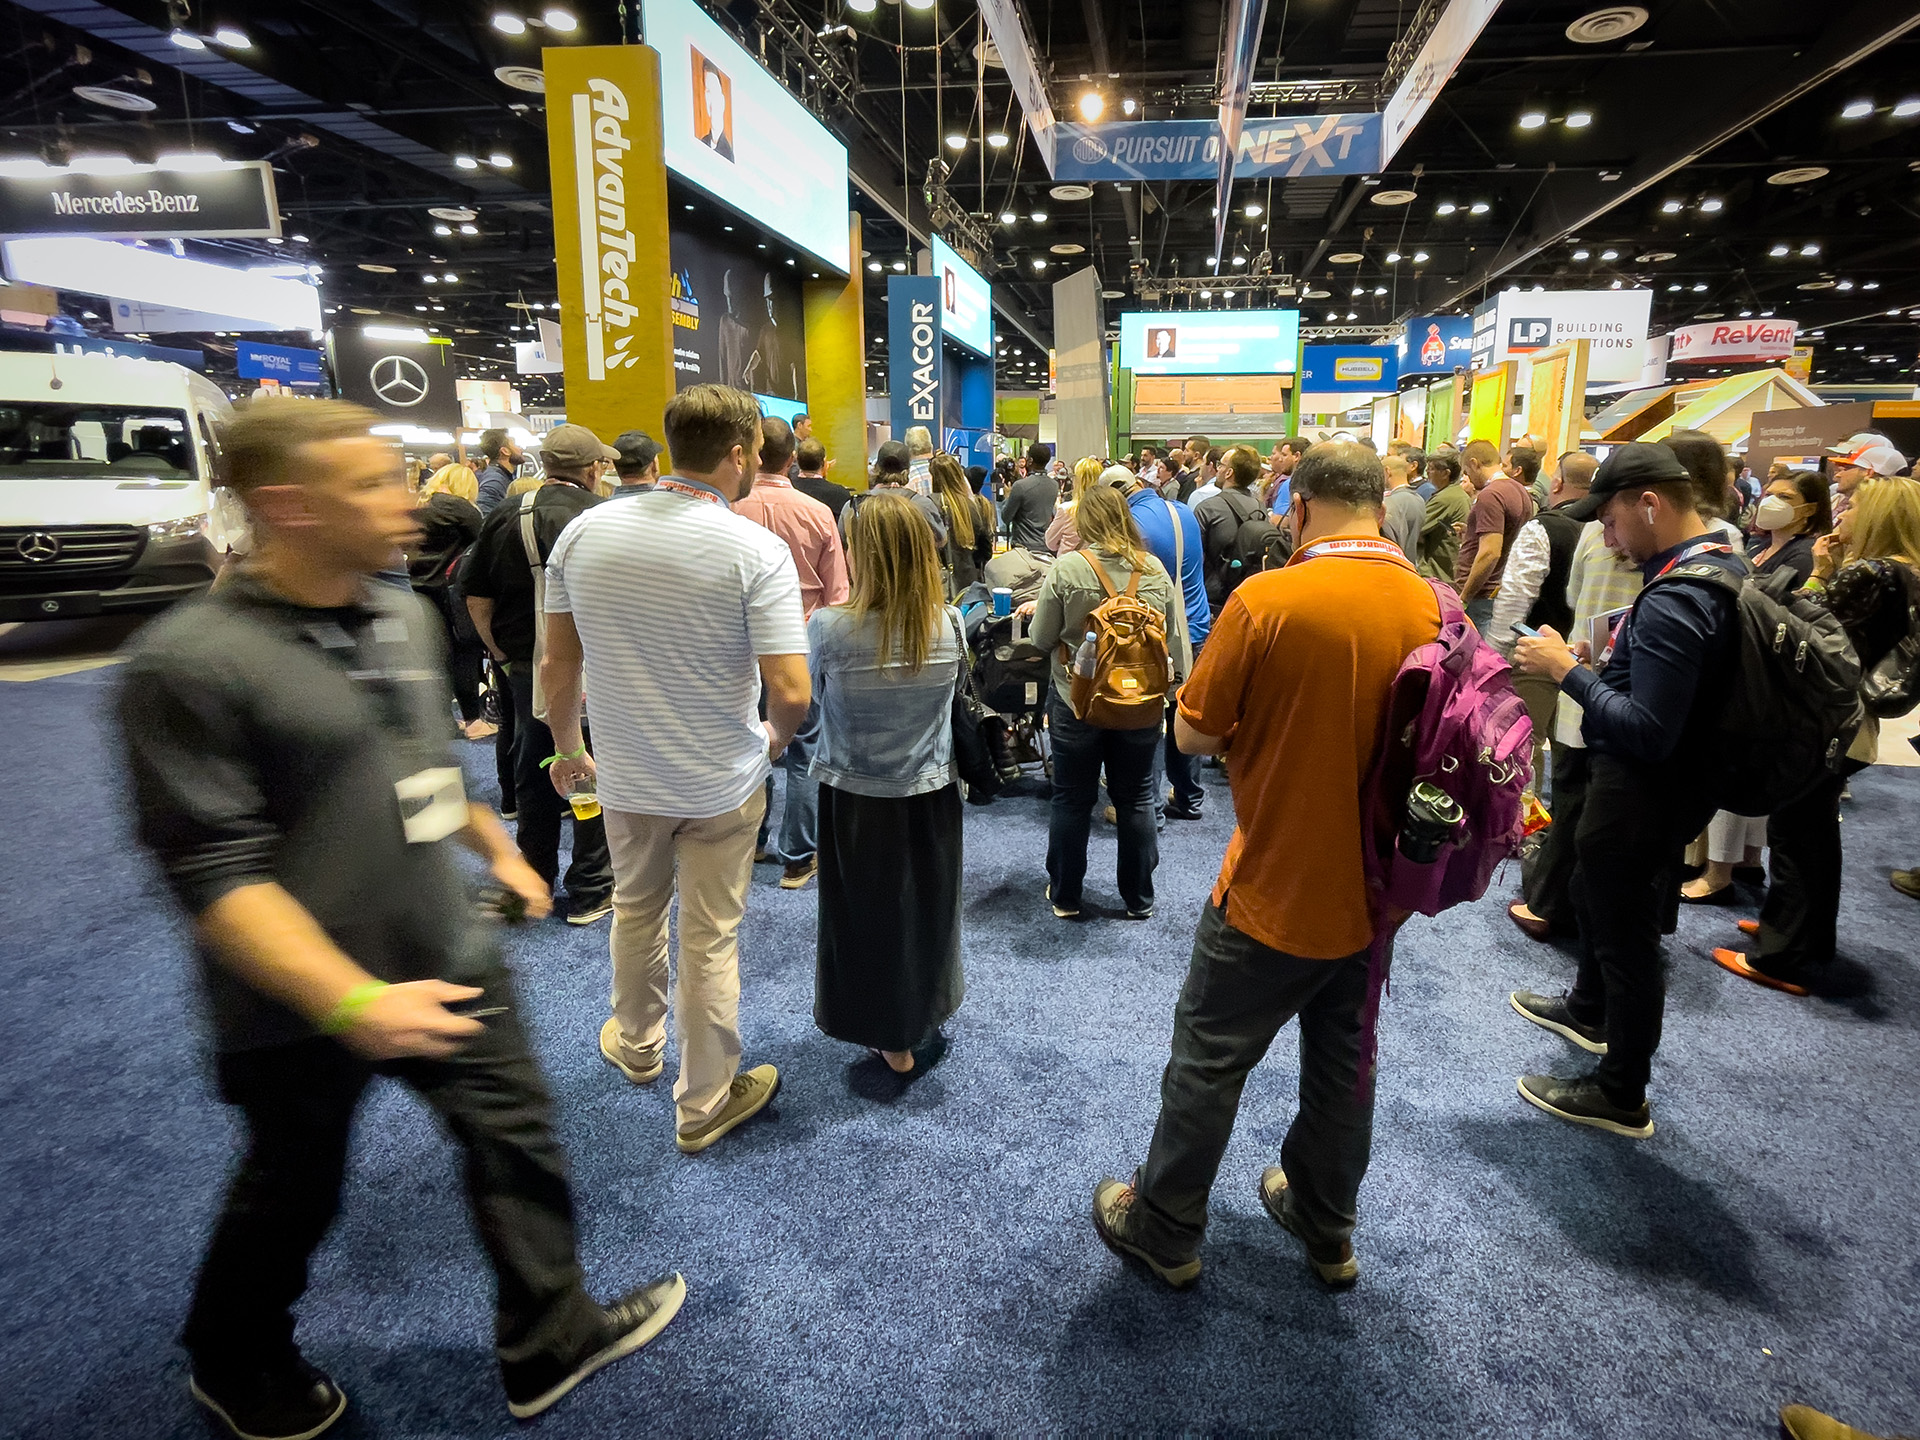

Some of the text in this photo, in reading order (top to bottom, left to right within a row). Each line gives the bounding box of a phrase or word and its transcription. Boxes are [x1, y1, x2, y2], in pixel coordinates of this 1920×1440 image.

[1112, 134, 1203, 164] PURSUIT
[1202, 139, 1222, 163] O
[51, 189, 200, 215] Mercedes-Benz
[588, 78, 639, 328] AdvanTech
[1556, 322, 1624, 334] BUILDING
[1710, 323, 1793, 346] ReVent
[1555, 338, 1634, 349] STIONS
[908, 302, 939, 420] EXACOR
